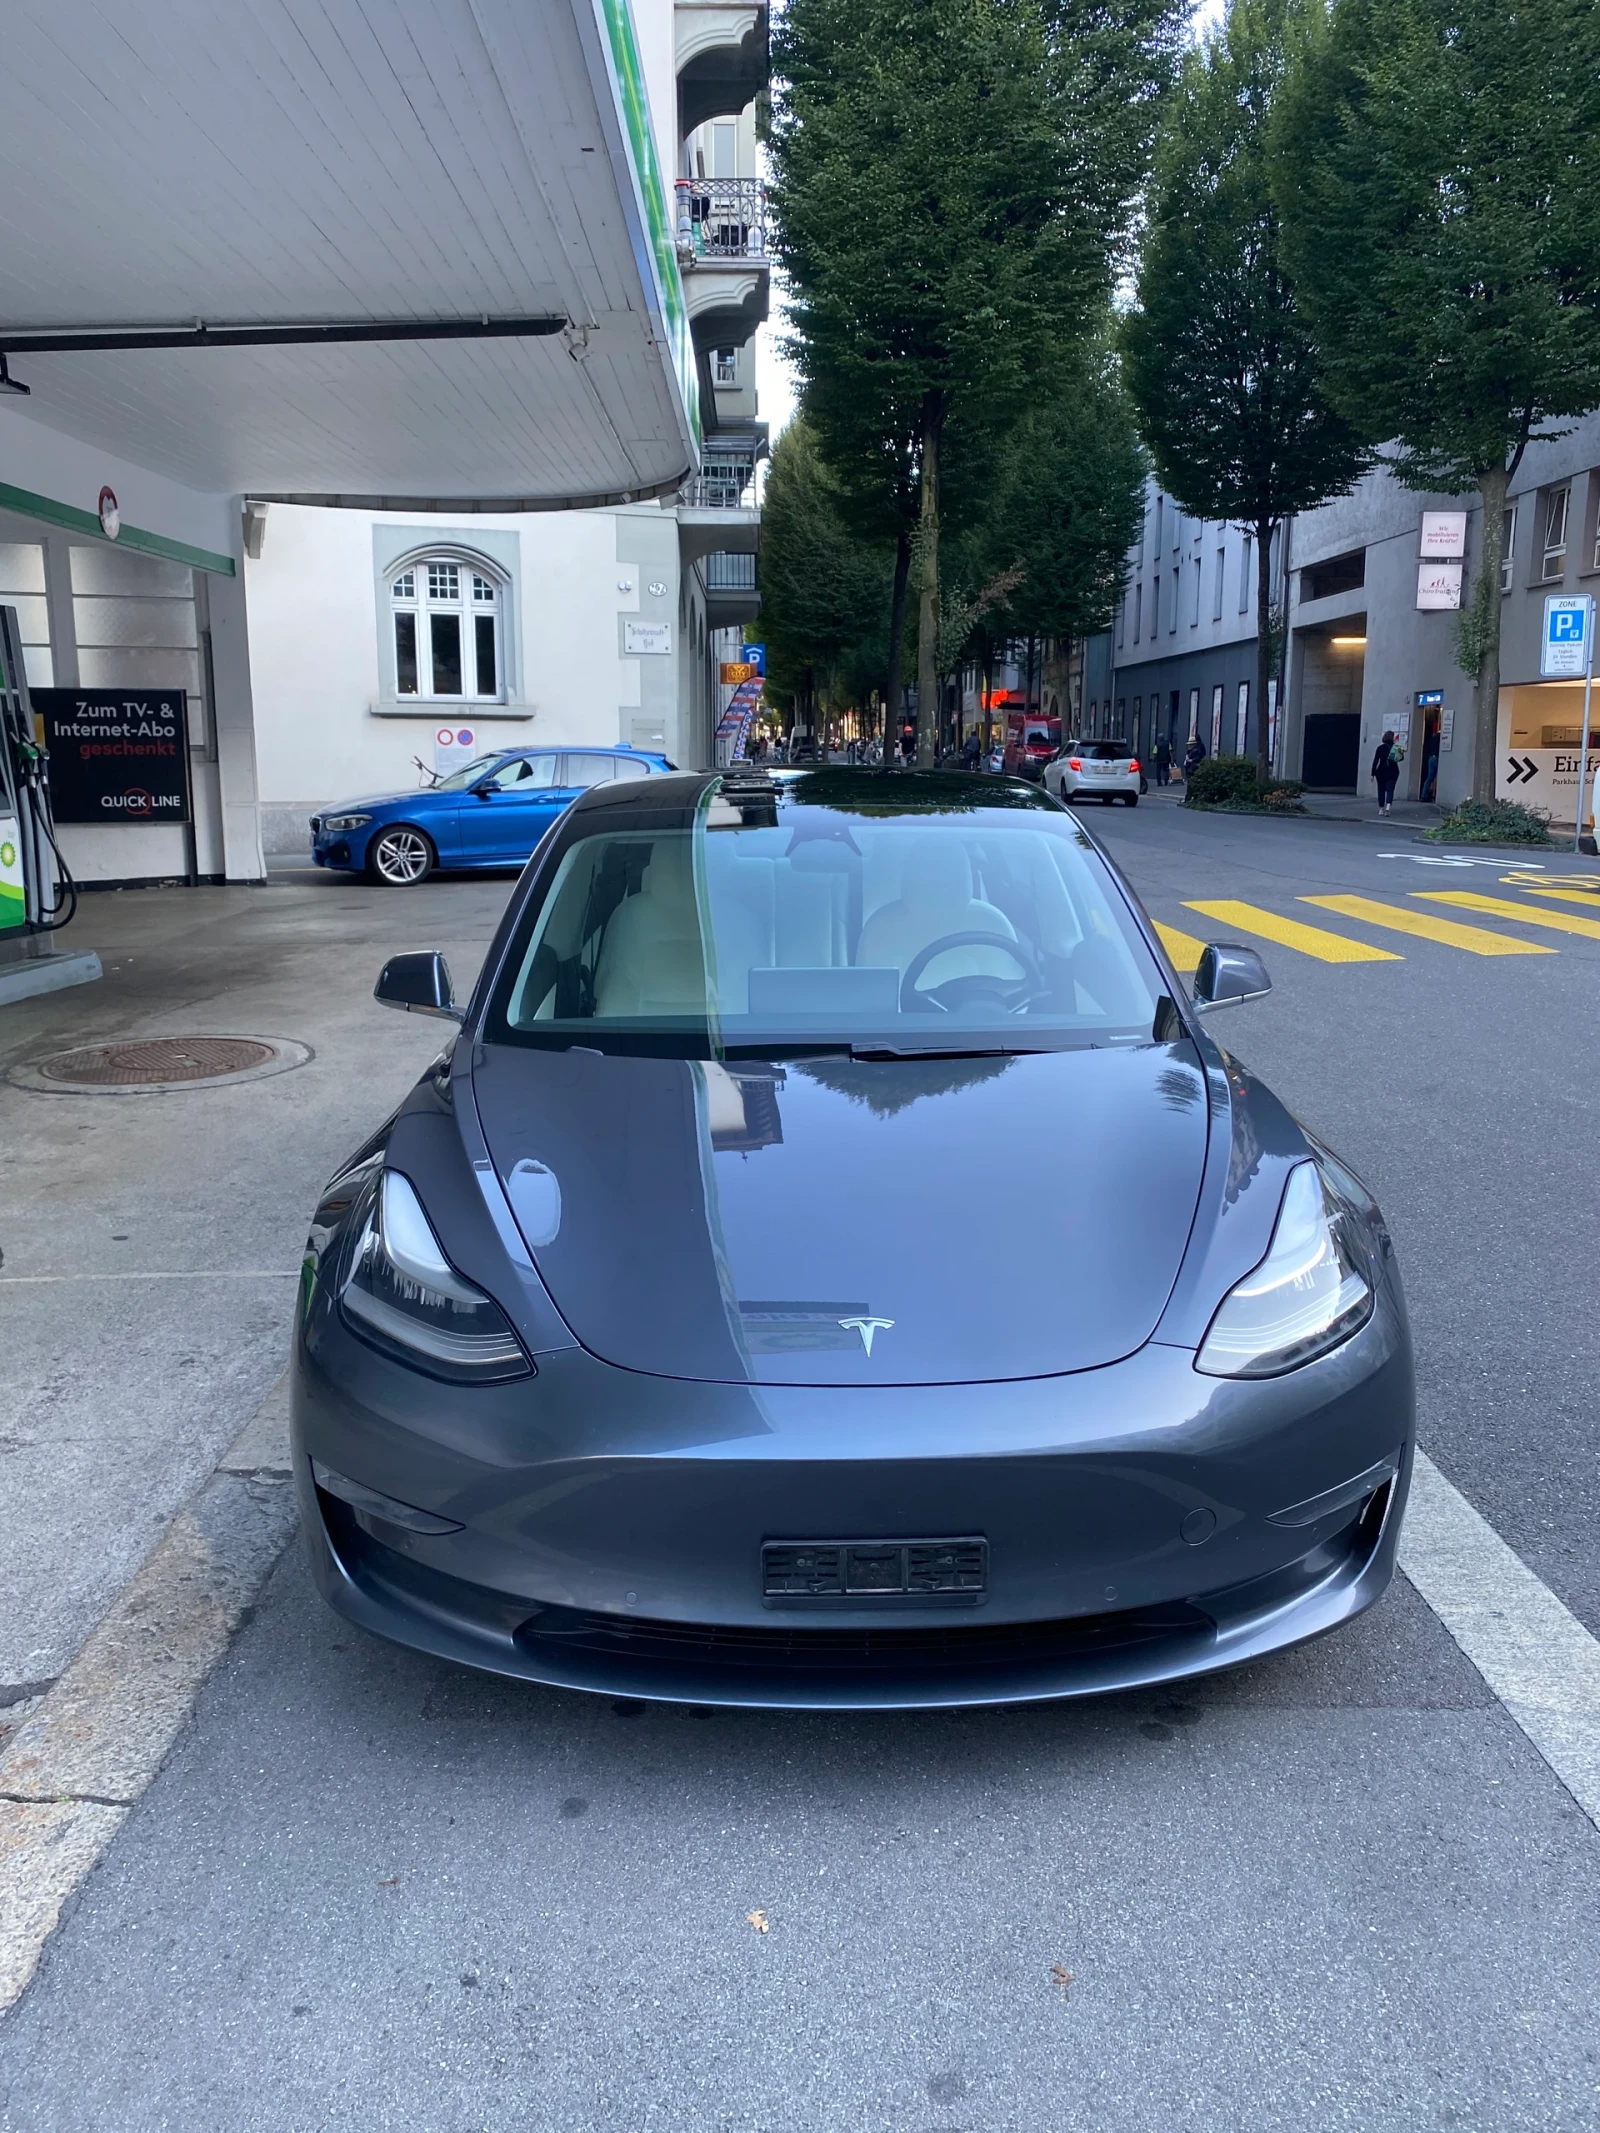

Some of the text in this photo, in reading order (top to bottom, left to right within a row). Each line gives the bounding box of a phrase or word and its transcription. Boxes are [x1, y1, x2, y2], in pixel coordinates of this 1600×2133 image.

[1558, 600, 1577, 608] ZONE
[1556, 614, 1573, 637] P
[749, 653, 760, 664] P
[76, 702, 175, 718] Zum TV- &
[54, 720, 175, 737] Internet-Abo
[79, 740, 176, 760] geschenkt
[1376, 853, 1546, 869] 30
